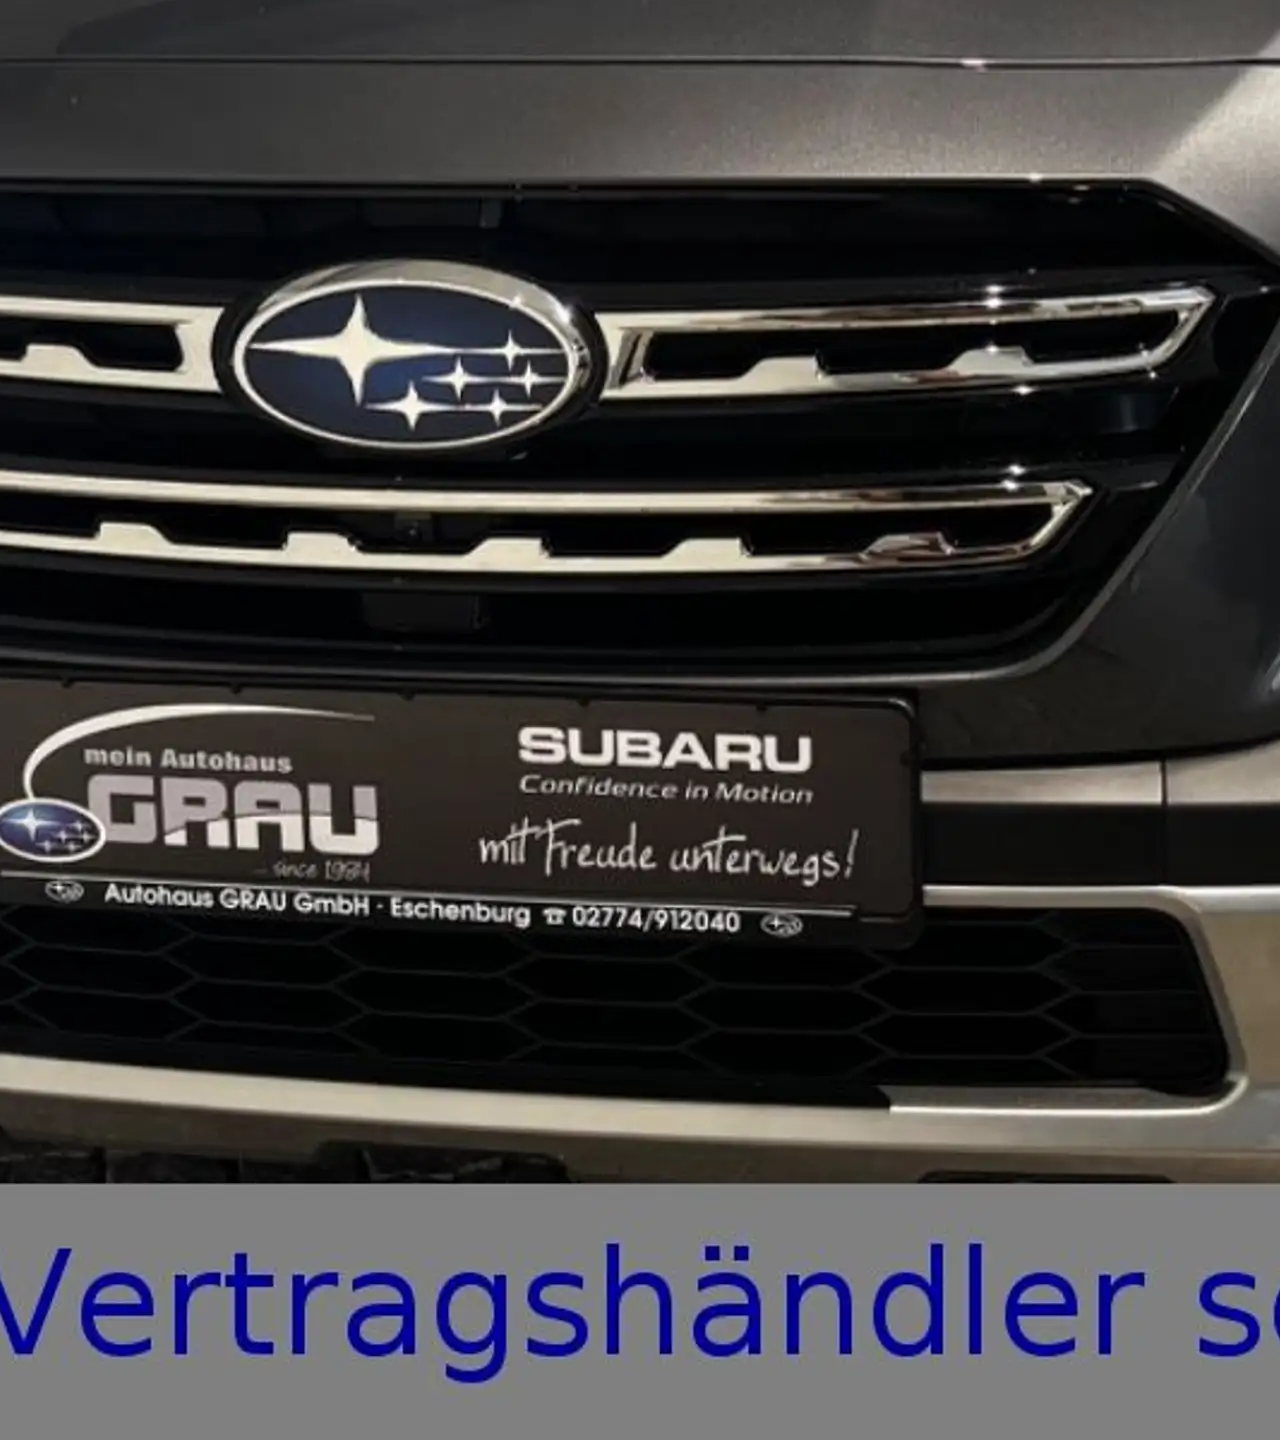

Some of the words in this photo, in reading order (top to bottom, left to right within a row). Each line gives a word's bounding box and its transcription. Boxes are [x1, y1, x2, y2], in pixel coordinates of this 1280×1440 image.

[84, 746, 152, 767] mein
[160, 748, 293, 774] Autohaus
[518, 726, 812, 774] SUBARU
[520, 774, 677, 800] Confidence
[685, 777, 709, 800] in
[715, 781, 813, 805] Motion
[87, 774, 381, 856] GRAU
[479, 817, 541, 865] mit
[545, 819, 657, 877] Freude
[669, 824, 860, 888] unterwegs!
[103, 883, 214, 910] Autohaus
[220, 888, 287, 912] GRAU
[294, 894, 371, 918] GmbH
[390, 898, 532, 928] Eschenburg
[572, 907, 742, 934] 02774/912040
